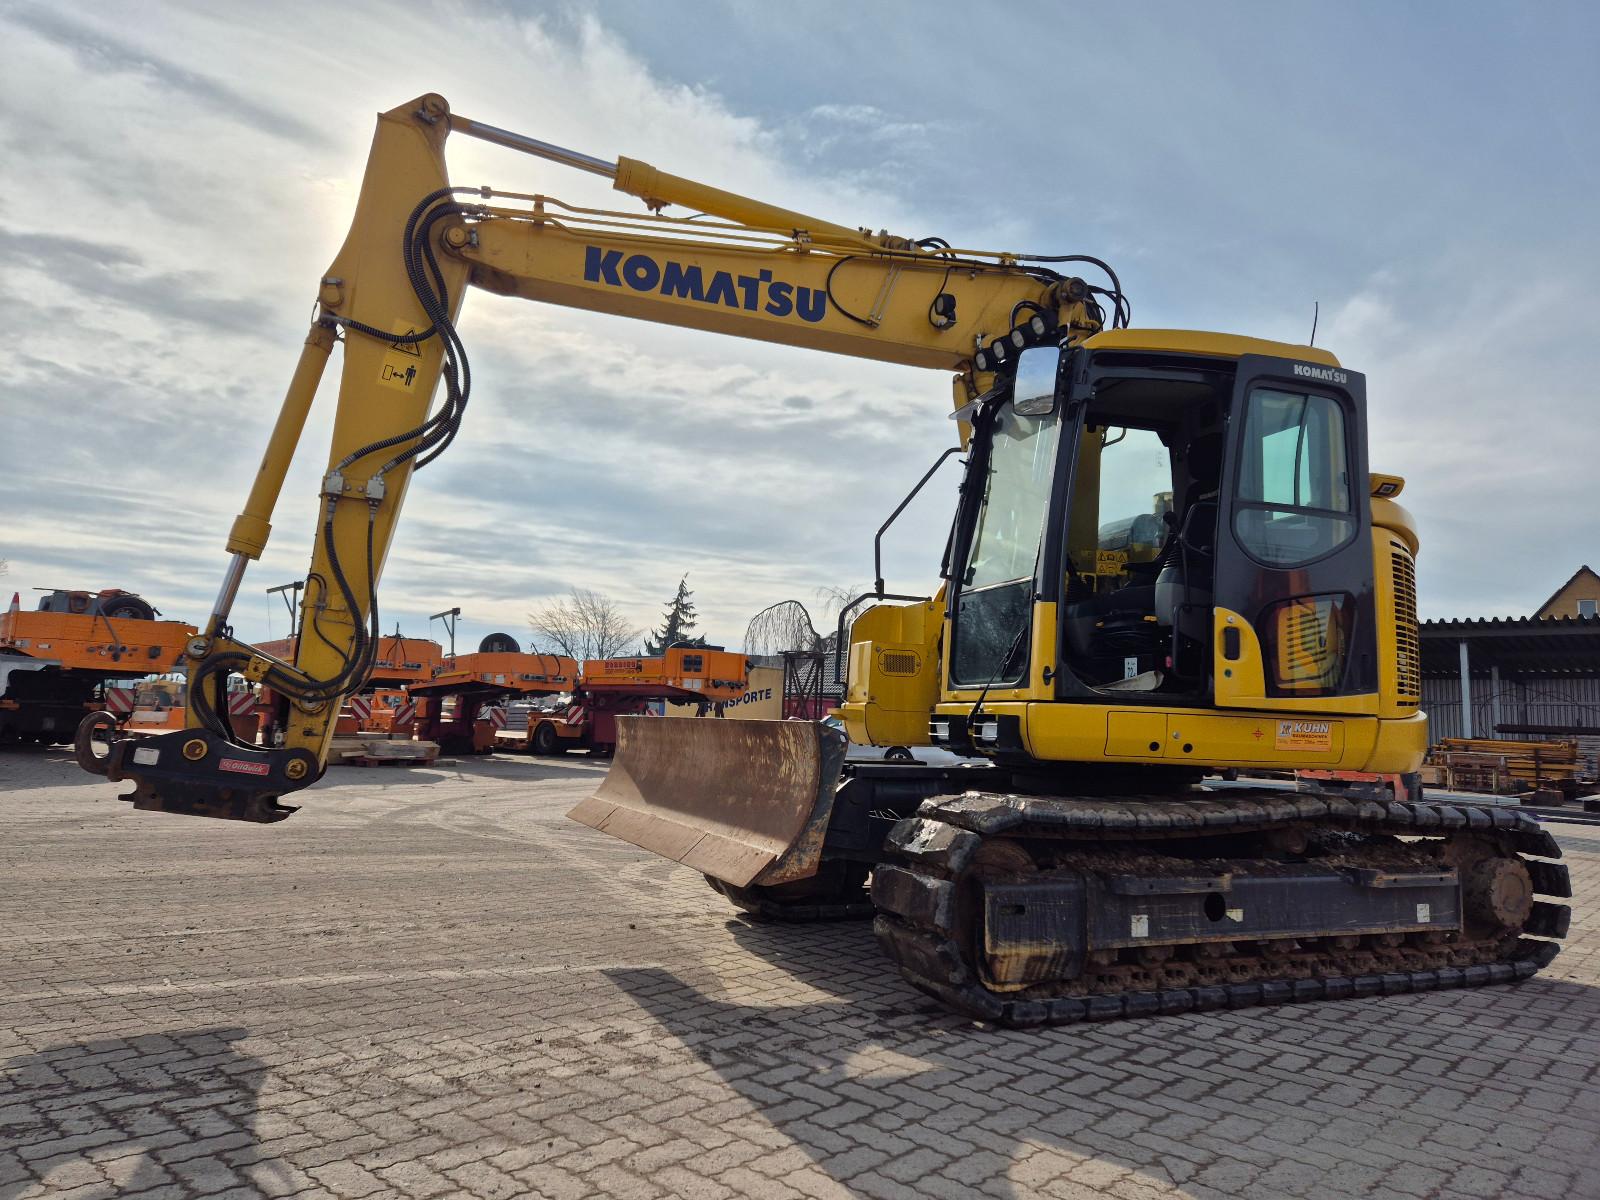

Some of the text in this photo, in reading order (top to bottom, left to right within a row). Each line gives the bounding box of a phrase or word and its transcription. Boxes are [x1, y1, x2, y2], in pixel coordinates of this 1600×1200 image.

[584, 246, 827, 323] KOMATSU
[1294, 364, 1347, 384] KOMATSU
[704, 688, 772, 712] RNSPORTE
[1294, 721, 1329, 734] KUHN
